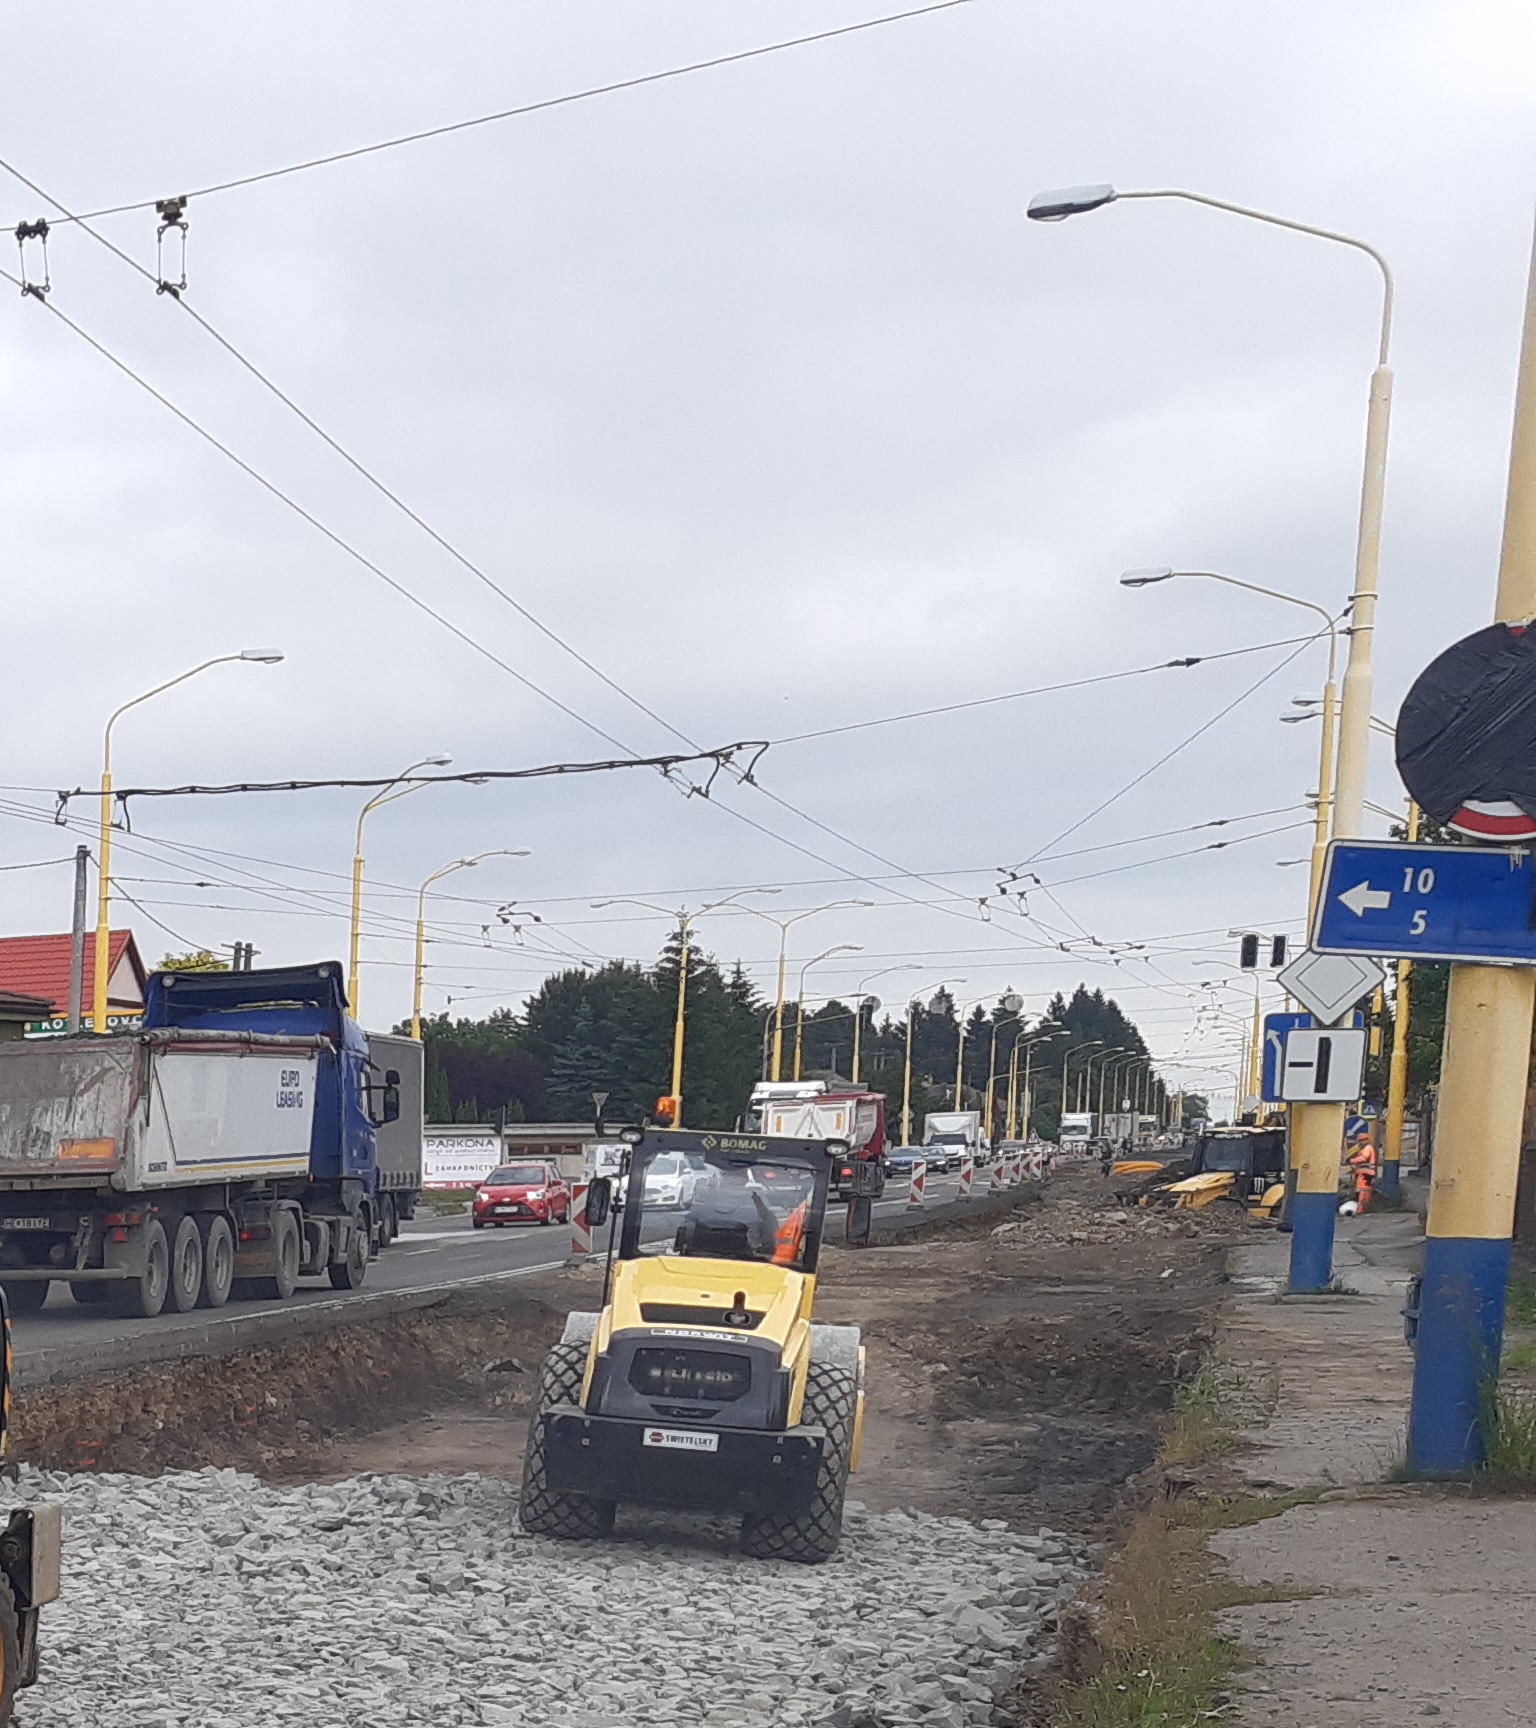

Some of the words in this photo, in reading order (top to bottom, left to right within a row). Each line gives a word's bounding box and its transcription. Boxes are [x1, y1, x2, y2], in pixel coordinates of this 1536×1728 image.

[1402, 867, 1435, 894] 10
[1409, 909, 1428, 935] 5
[426, 1138, 495, 1148] PARKONA
[720, 1138, 767, 1151] BOMAG
[665, 1434, 713, 1446] SWIETELSKY
